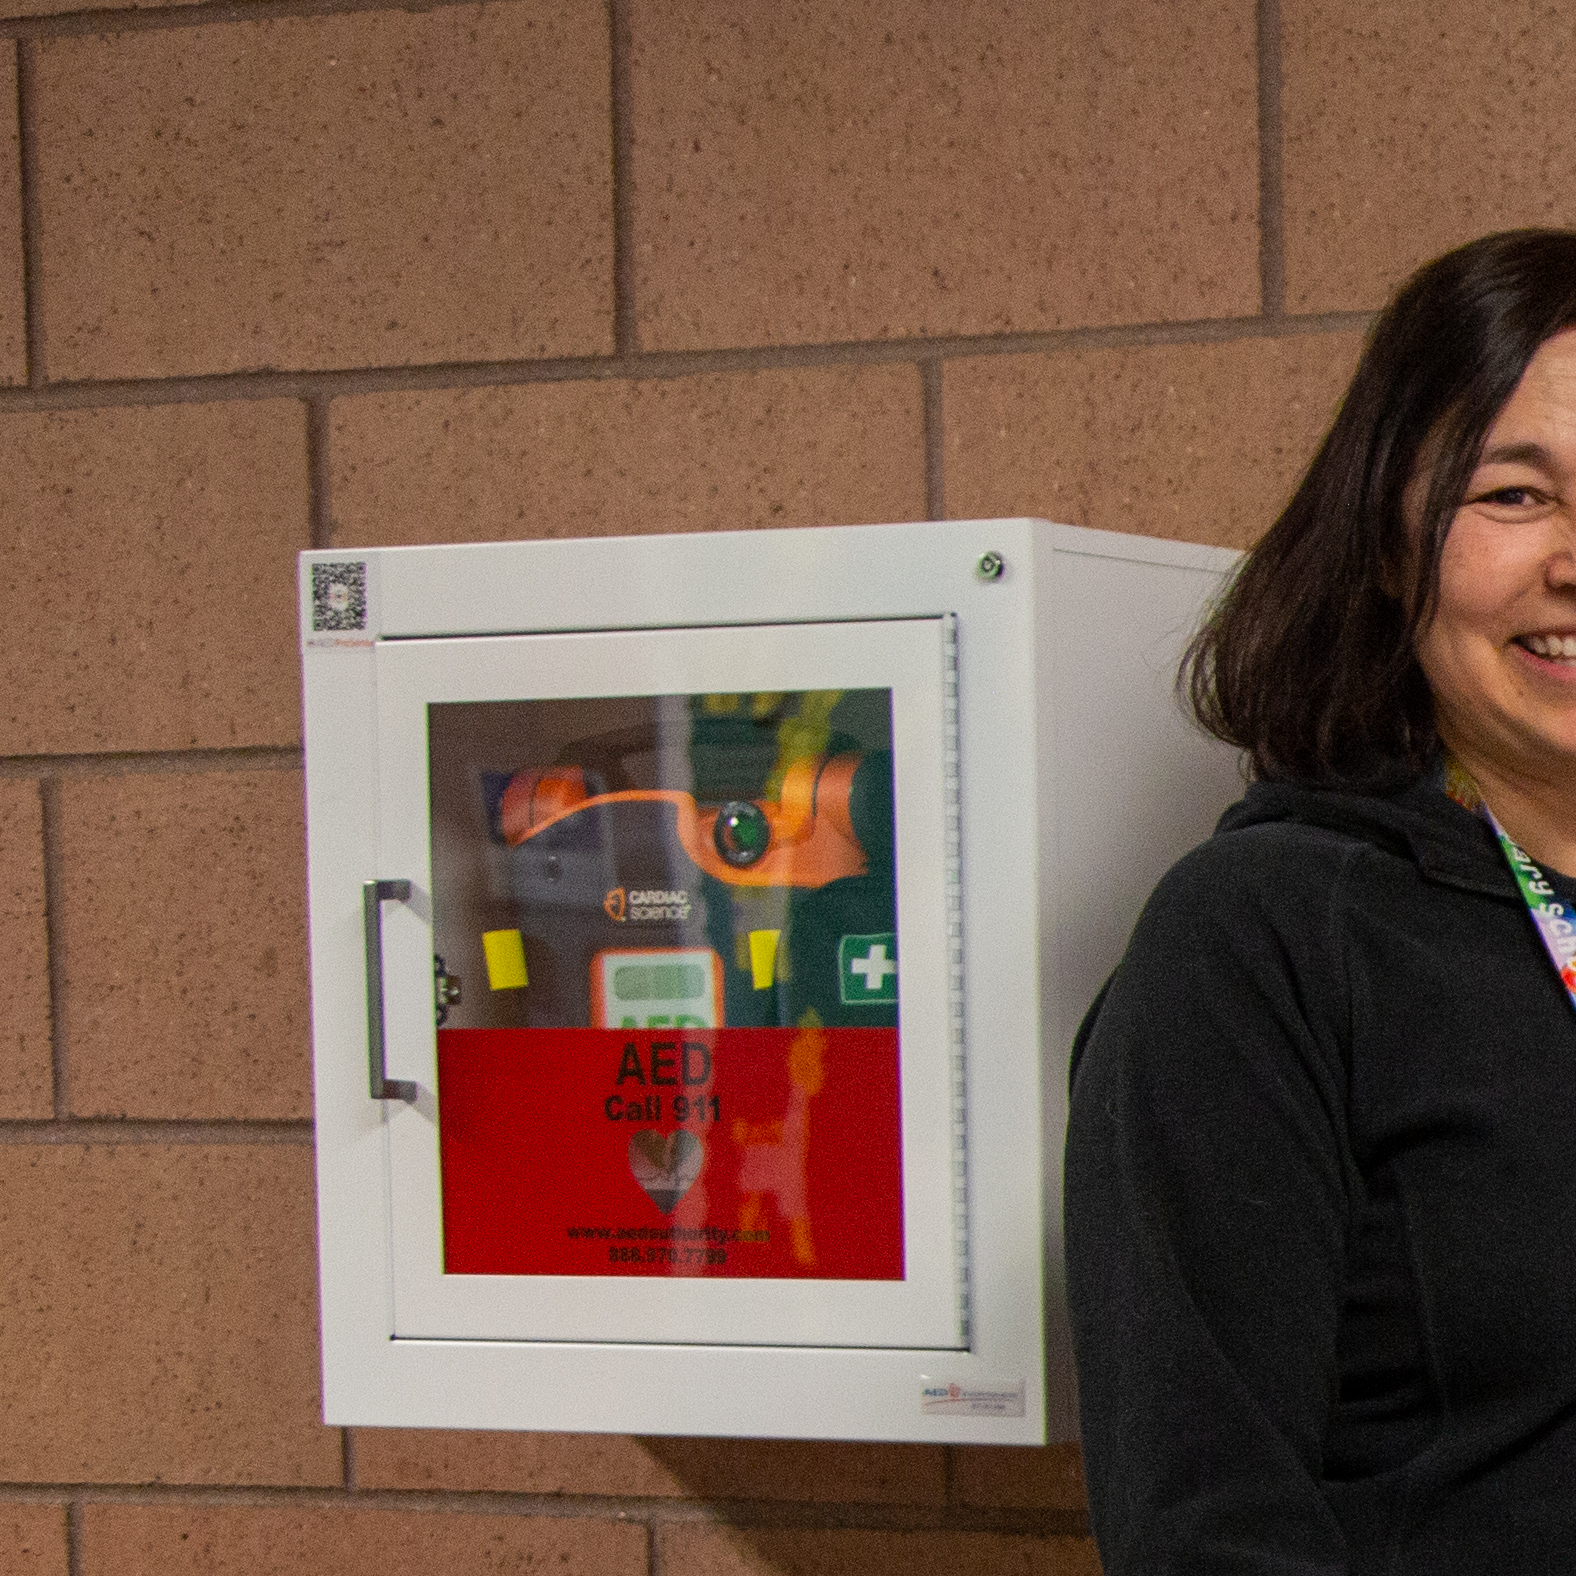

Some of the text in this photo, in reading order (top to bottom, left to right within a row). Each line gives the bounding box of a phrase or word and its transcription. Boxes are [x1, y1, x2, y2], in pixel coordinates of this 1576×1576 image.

[629, 890, 688, 904] CARDIAC
[616, 1041, 713, 1086] AED
[603, 1095, 722, 1122] Call 911
